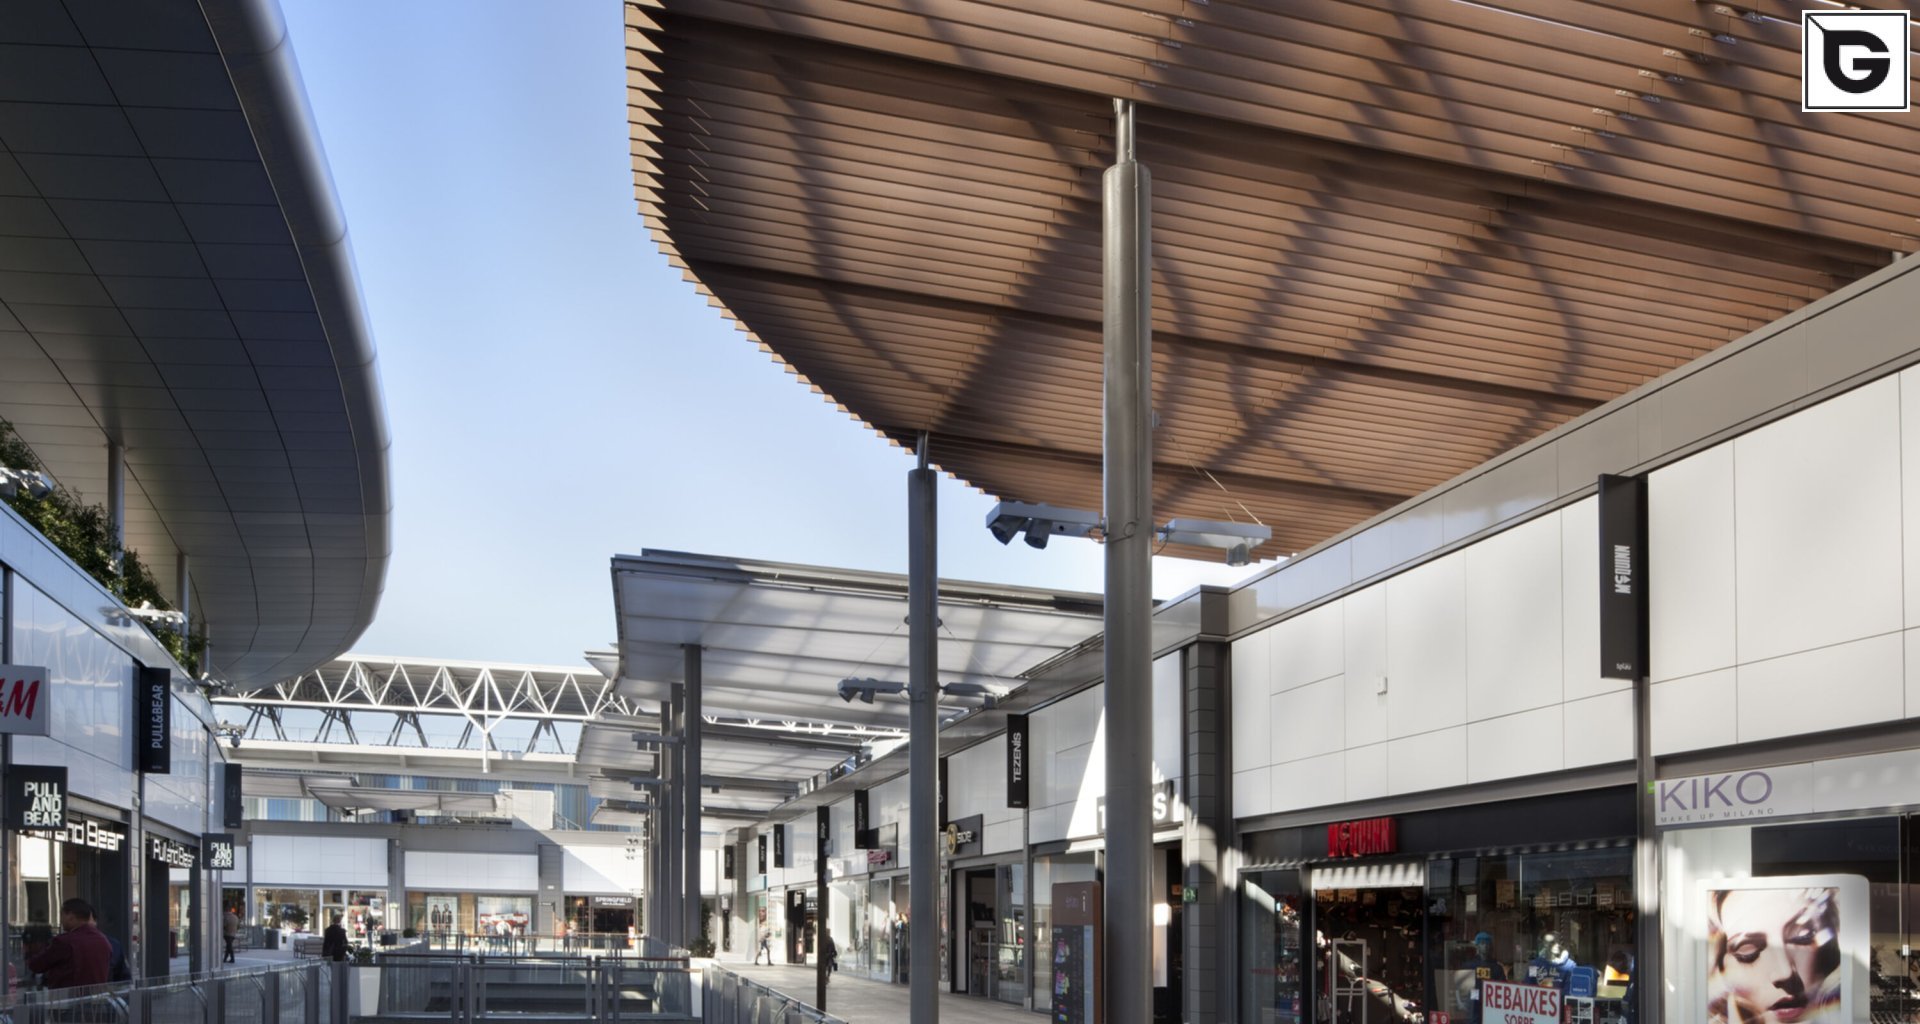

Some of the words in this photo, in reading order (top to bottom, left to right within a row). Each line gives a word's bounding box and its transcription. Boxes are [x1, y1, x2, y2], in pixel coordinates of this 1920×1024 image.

[151, 685, 164, 749] PULL&BEAR
[24, 781, 62, 798] PULL
[1660, 771, 1774, 813] KIKO
[31, 797, 62, 812] AND
[23, 811, 62, 827] BEAR
[1660, 814, 1692, 824] MAKE
[1700, 812, 1715, 821] UP
[1723, 807, 1775, 819] MILANO
[86, 820, 125, 852] Bear
[210, 842, 232, 852] PULL
[214, 849, 232, 860] AND
[210, 858, 232, 868] BEAR
[1484, 983, 1558, 1017] REBAIXES
